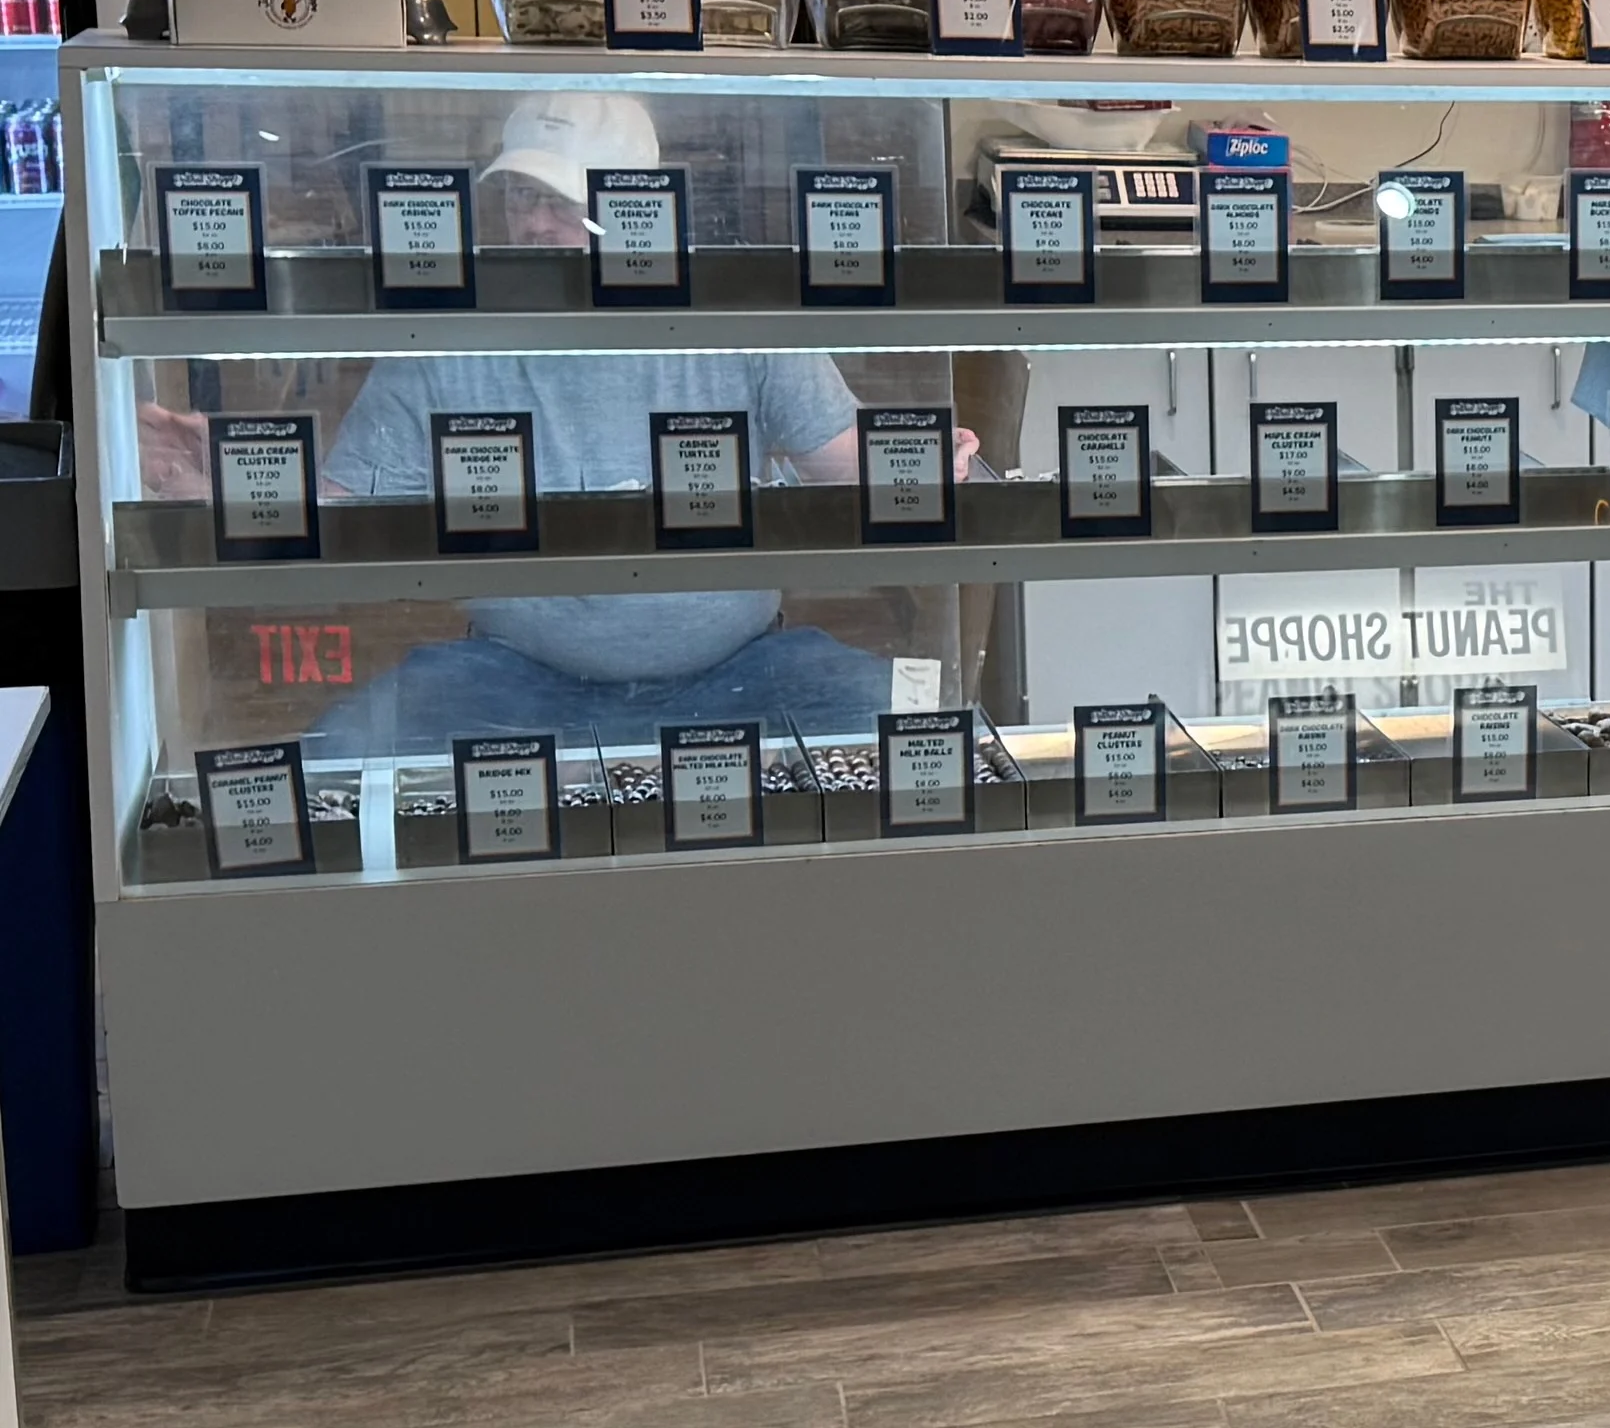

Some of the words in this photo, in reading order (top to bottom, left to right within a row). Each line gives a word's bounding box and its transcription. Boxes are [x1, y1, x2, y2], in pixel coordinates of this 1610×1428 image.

[640, 11, 666, 20] $3.50
[964, 11, 988, 20] $2.00
[1229, 138, 1268, 157] Ziploc
[180, 199, 231, 207] CHOCOLATE
[608, 200, 662, 208] CHOCOLATE
[172, 208, 206, 216] TOFFEE
[209, 208, 244, 216] PECANS
[614, 210, 658, 218] CASHEWS
[192, 221, 226, 231] $15.00
[621, 221, 653, 230] $15.00
[198, 261, 226, 271] $4.00
[626, 259, 653, 268] $4.00
[224, 447, 264, 456] VANILLA
[266, 446, 299, 455] CREAM
[237, 456, 287, 466] CLUSTERS
[246, 470, 280, 480] $17.00
[252, 510, 280, 519] $4.50
[478, 769, 511, 778] BRIDGE
[515, 768, 531, 776] MIX
